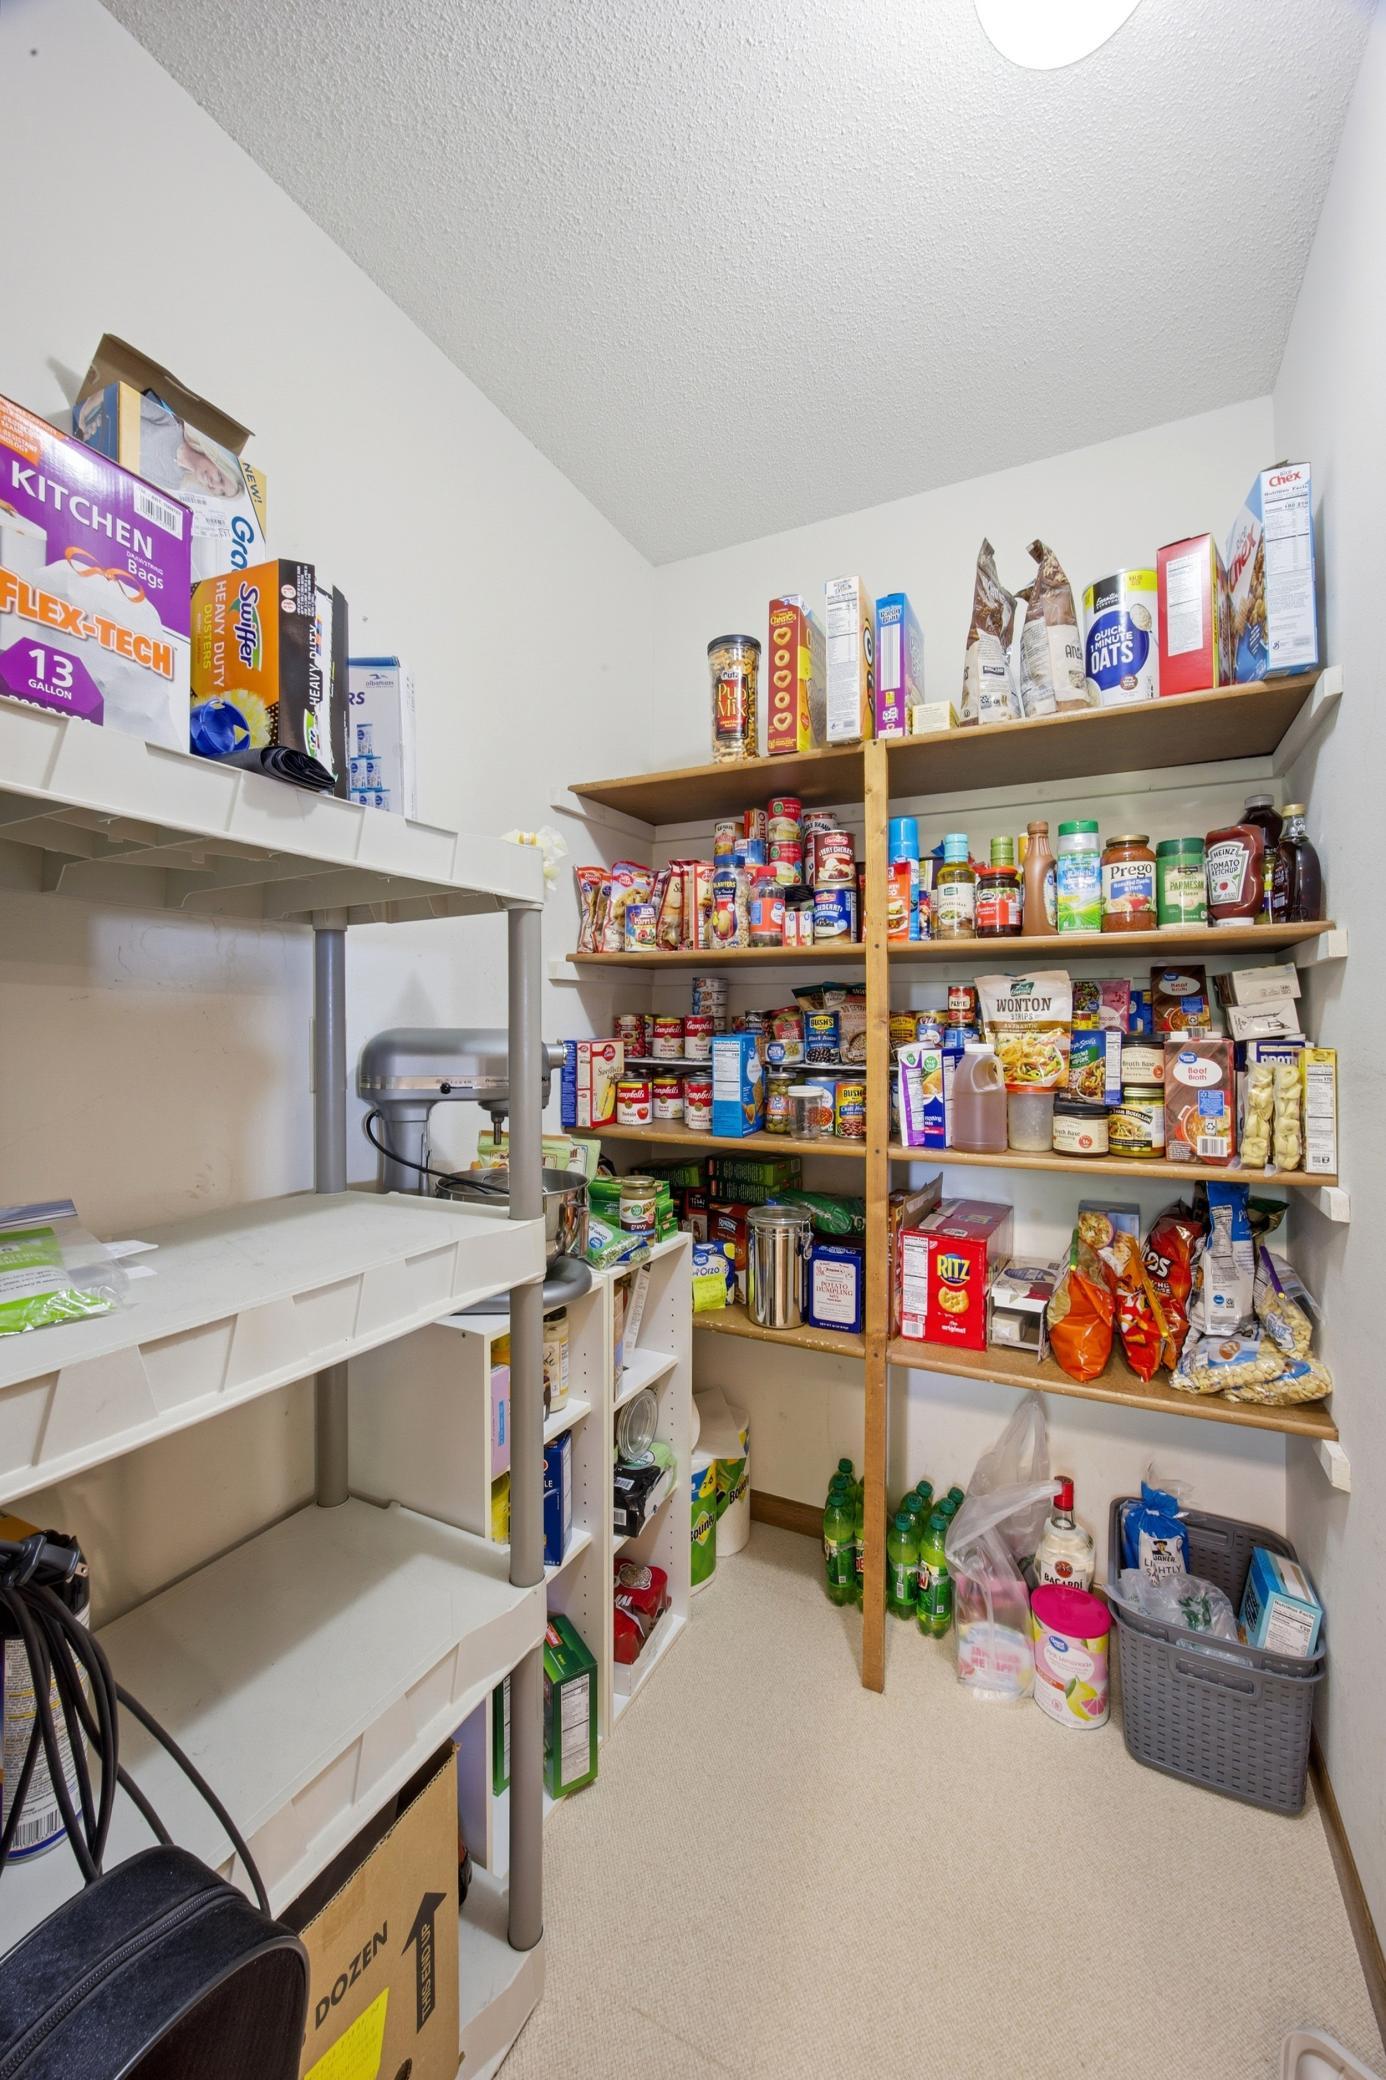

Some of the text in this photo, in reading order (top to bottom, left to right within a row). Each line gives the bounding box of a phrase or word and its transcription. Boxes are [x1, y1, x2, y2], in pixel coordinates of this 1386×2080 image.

[242, 462, 262, 504] NEW!
[1268, 471, 1302, 487] Chex
[12, 460, 152, 560] KITCHEN
[128, 559, 164, 589] Bags
[0, 568, 175, 681] FLEX-TECH
[212, 580, 227, 688] HEAVY DUTY
[232, 580, 260, 670] Swiffer
[1094, 623, 1126, 642] QUICK
[203, 604, 213, 670] DUSTERS
[1095, 631, 1134, 650] MINUTE
[28, 648, 73, 688] 13
[1091, 641, 1134, 675] OATS
[28, 678, 72, 700] GALLON
[308, 665, 323, 706] HEAVY
[718, 699, 747, 718] Mix
[1213, 848, 1236, 858] HEINZ
[1110, 863, 1153, 880] Prego
[1210, 859, 1241, 871] TOMATO
[1211, 866, 1240, 877] KETCHUP
[996, 997, 1053, 1013] WONTON
[654, 1024, 683, 1035] Campbell's
[810, 1017, 834, 1027] BUSH'S
[700, 1267, 720, 1275] Orzo
[937, 1254, 971, 1281] RITZ
[815, 1285, 854, 1297] DUMPLING
[820, 1281, 849, 1290] POTATO
[421, 1923, 431, 1947] UP
[315, 1920, 388, 2031] DOZEN
[421, 1978, 432, 2023] THIS
